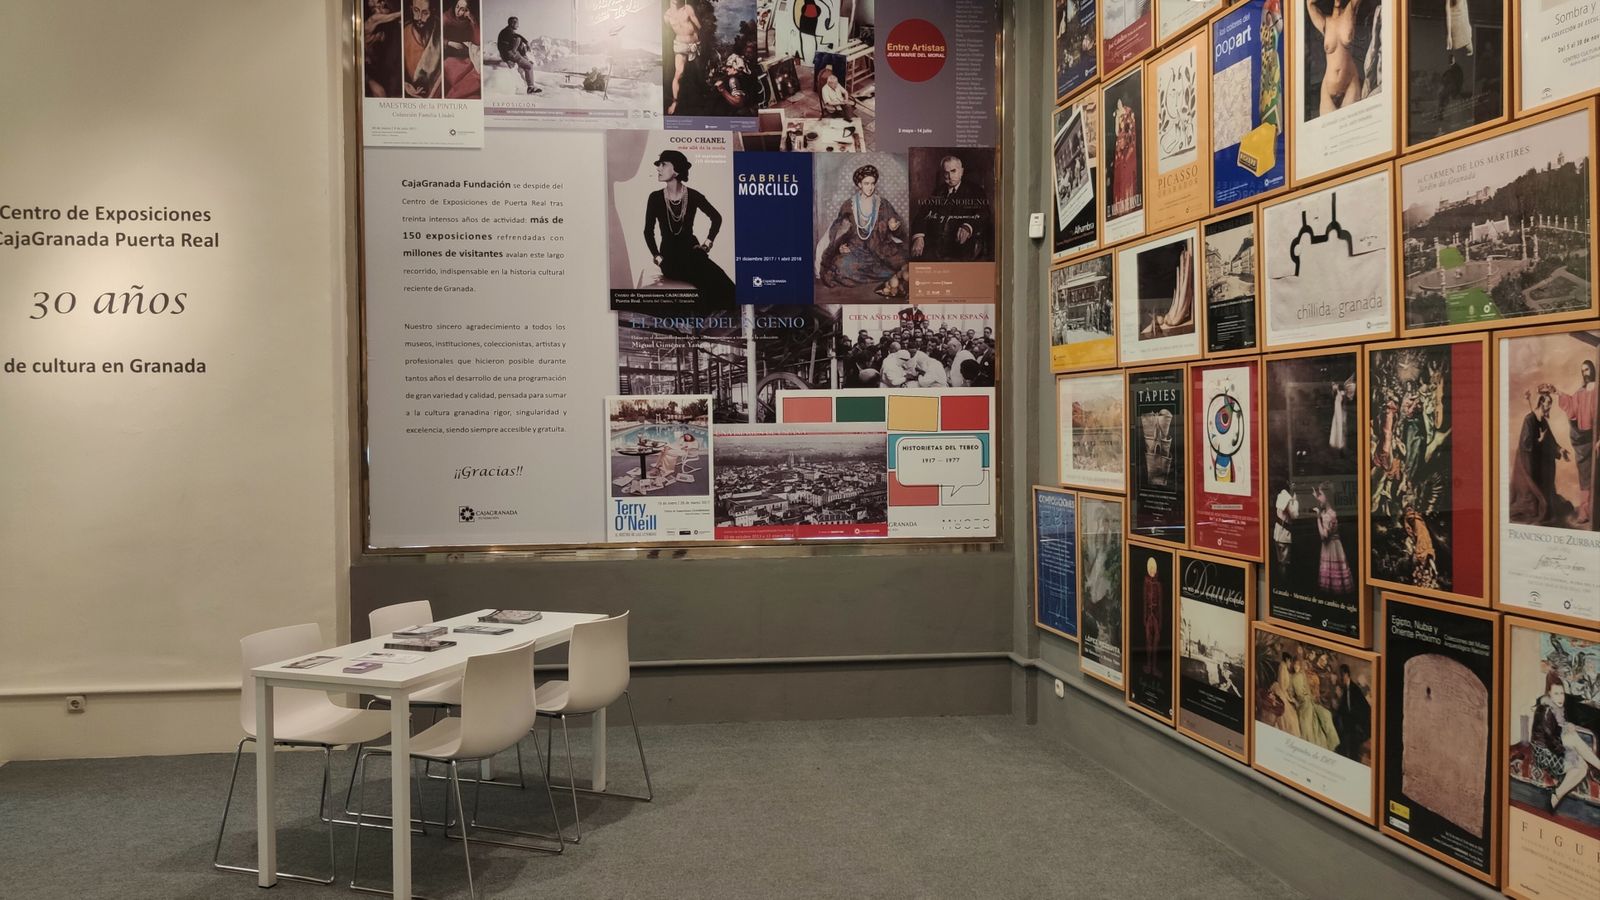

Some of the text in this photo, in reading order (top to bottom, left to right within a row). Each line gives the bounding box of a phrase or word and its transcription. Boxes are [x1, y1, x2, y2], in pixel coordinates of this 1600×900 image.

[1555, 2, 1596, 25] Sombra y
[887, 43, 945, 52] Entre Artistas
[1215, 25, 1251, 62] popart
[1424, 168, 1455, 182] CARMEN
[1457, 163, 1468, 173] DE
[1470, 159, 1484, 170] LOS
[738, 174, 798, 182] GABRIEL
[1158, 165, 1198, 189] PICASSO
[402, 179, 461, 189] CajaGranada
[463, 179, 511, 189] Fundación
[523, 182, 550, 191] despide
[738, 183, 798, 196] MORCILLO
[443, 199, 488, 207] Exposiciones
[0, 205, 211, 224] Centro de Exposiciones
[530, 216, 549, 224] más
[552, 216, 563, 224] de
[116, 233, 175, 247] Puerta
[182, 233, 219, 247] Real
[402, 232, 421, 240] 150
[426, 232, 492, 242] exposiciones
[403, 250, 442, 258] millones
[445, 250, 457, 258] de
[459, 250, 503, 258] visitantes
[547, 252, 564, 260] largo
[440, 268, 488, 277] indispensable
[29, 285, 188, 319] 30 años
[1297, 296, 1382, 320] chillida granada
[870, 312, 891, 320] AÑOS
[960, 312, 989, 320] ESPAÑA
[466, 323, 521, 332] agradecimiento
[632, 317, 650, 328] EL
[654, 317, 704, 329] PODER
[709, 317, 736, 328] DEL
[632, 340, 655, 349] Miguel
[4, 359, 206, 373] de cultura en Granada
[405, 358, 453, 366] profesionales
[509, 358, 535, 366] posible
[518, 375, 567, 383] programación
[498, 392, 527, 400] pensada
[1138, 388, 1176, 402] TÀPIES
[454, 409, 490, 418] granadina
[493, 409, 512, 418] rigor,
[516, 409, 559, 418] singularidad
[470, 426, 499, 435] siempre
[538, 426, 566, 434] gratuita.
[454, 465, 524, 479] ¡¡Gracias!!
[615, 500, 646, 518] Terry
[1508, 529, 1552, 542] FRANCISCO
[1554, 535, 1565, 544] DE
[1324, 600, 1340, 609] cambio
[1392, 615, 1439, 635] Egipto, Nubia y
[1392, 625, 1441, 645] Oriente Próximo
[1475, 641, 1490, 650] Museo
